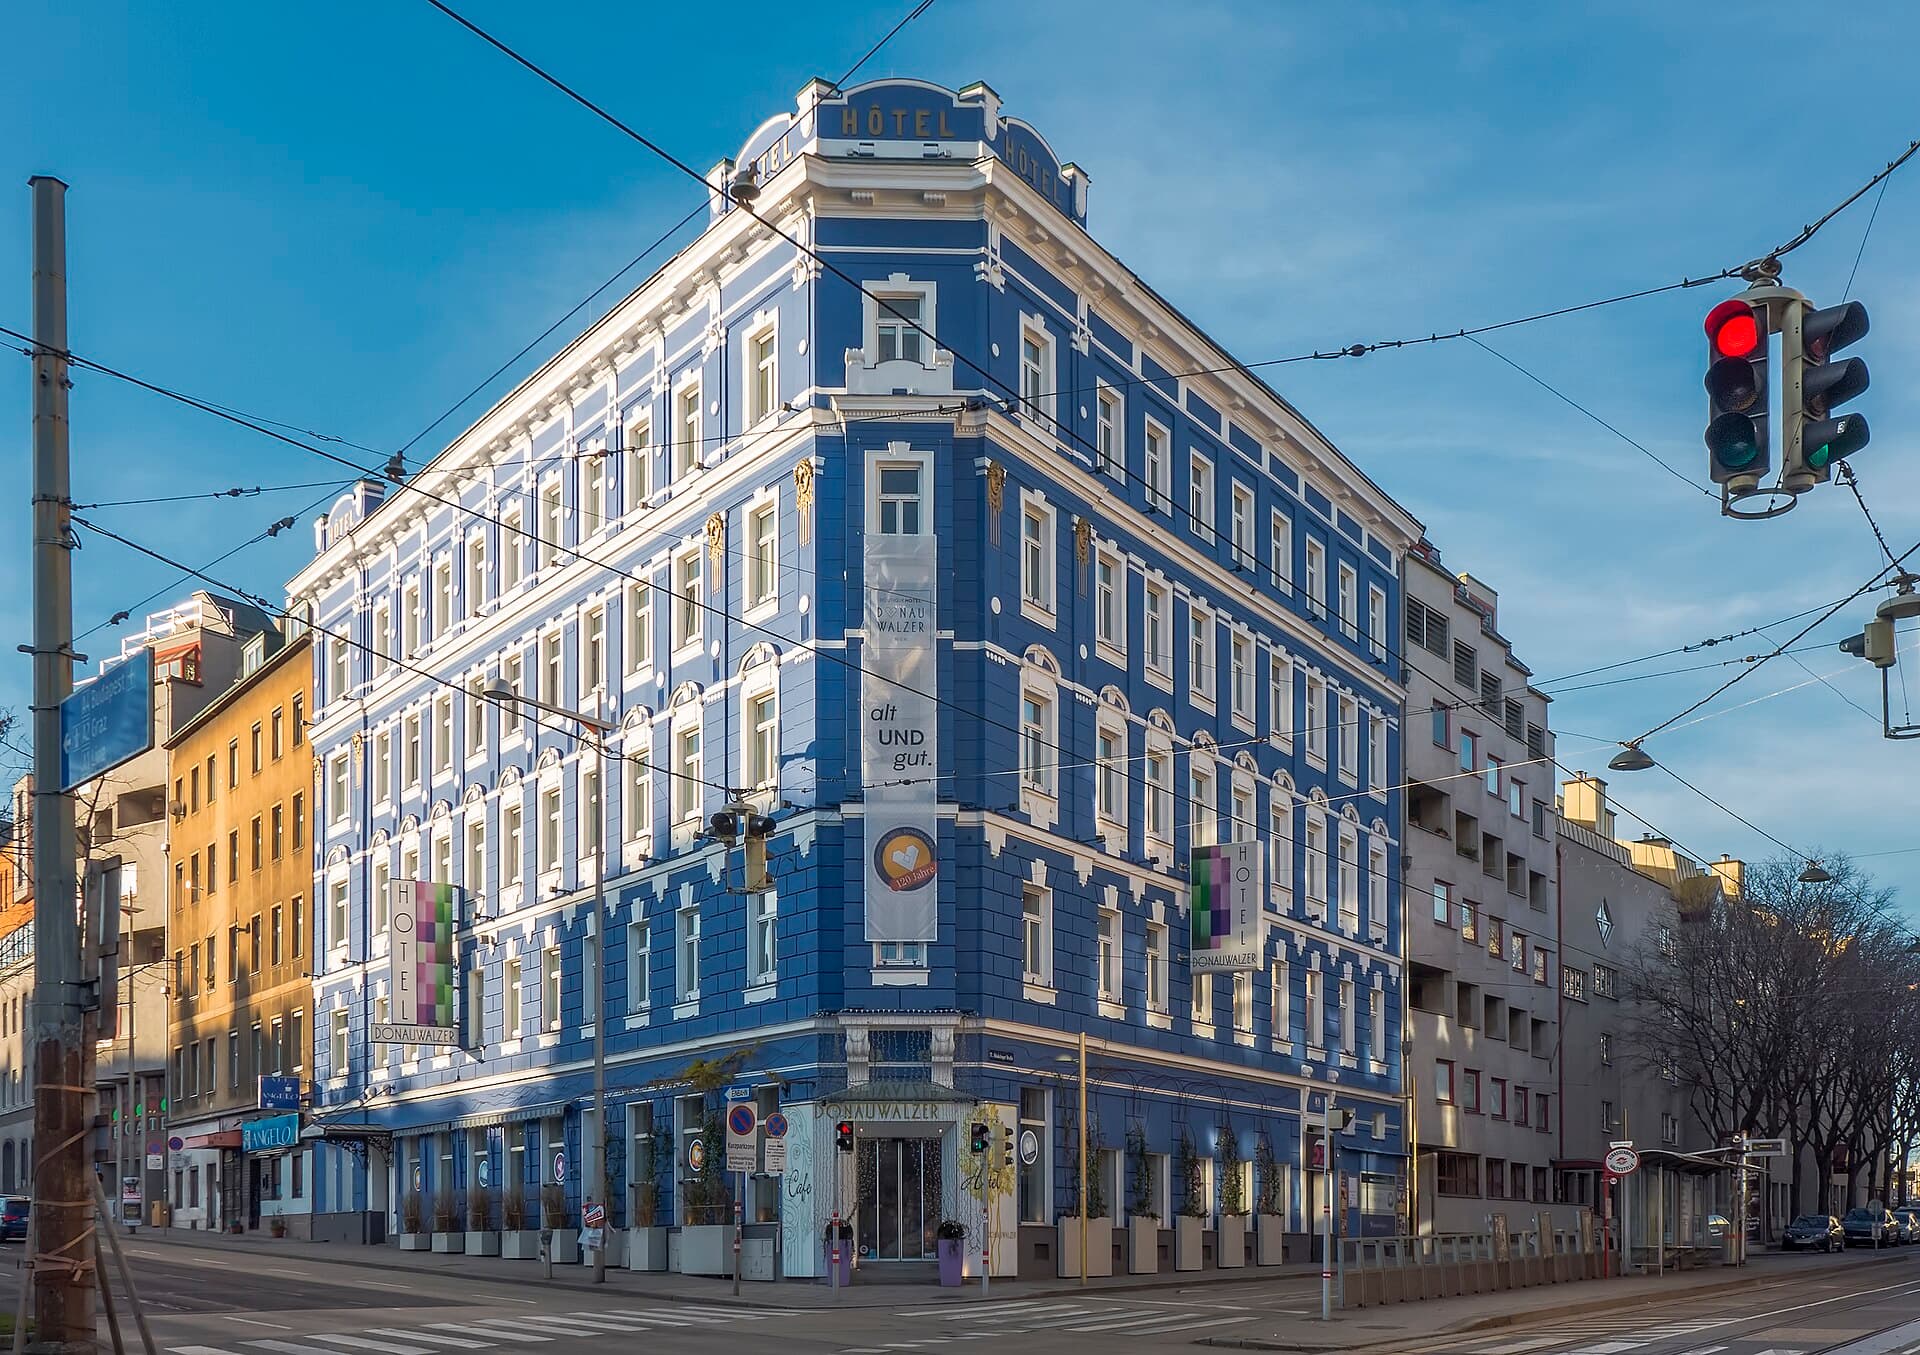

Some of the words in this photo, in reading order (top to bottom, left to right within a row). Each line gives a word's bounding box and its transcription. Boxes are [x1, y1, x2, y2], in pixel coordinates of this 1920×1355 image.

[841, 103, 955, 139] HÔTEL
[877, 621, 925, 633] WALZER
[870, 704, 897, 721] alt
[879, 729, 924, 745] UND
[893, 750, 932, 771] gut.
[895, 875, 911, 888] 120
[1236, 845, 1250, 946] HOTEL
[394, 883, 414, 1021] HOTEL
[1192, 952, 1257, 968] DONAUWALZER
[374, 1026, 455, 1043] DONAUWALZER
[814, 1103, 939, 1120] DONAUWALZER
[251, 1126, 291, 1147] ANGELO
[961, 1168, 1000, 1190] Htel
